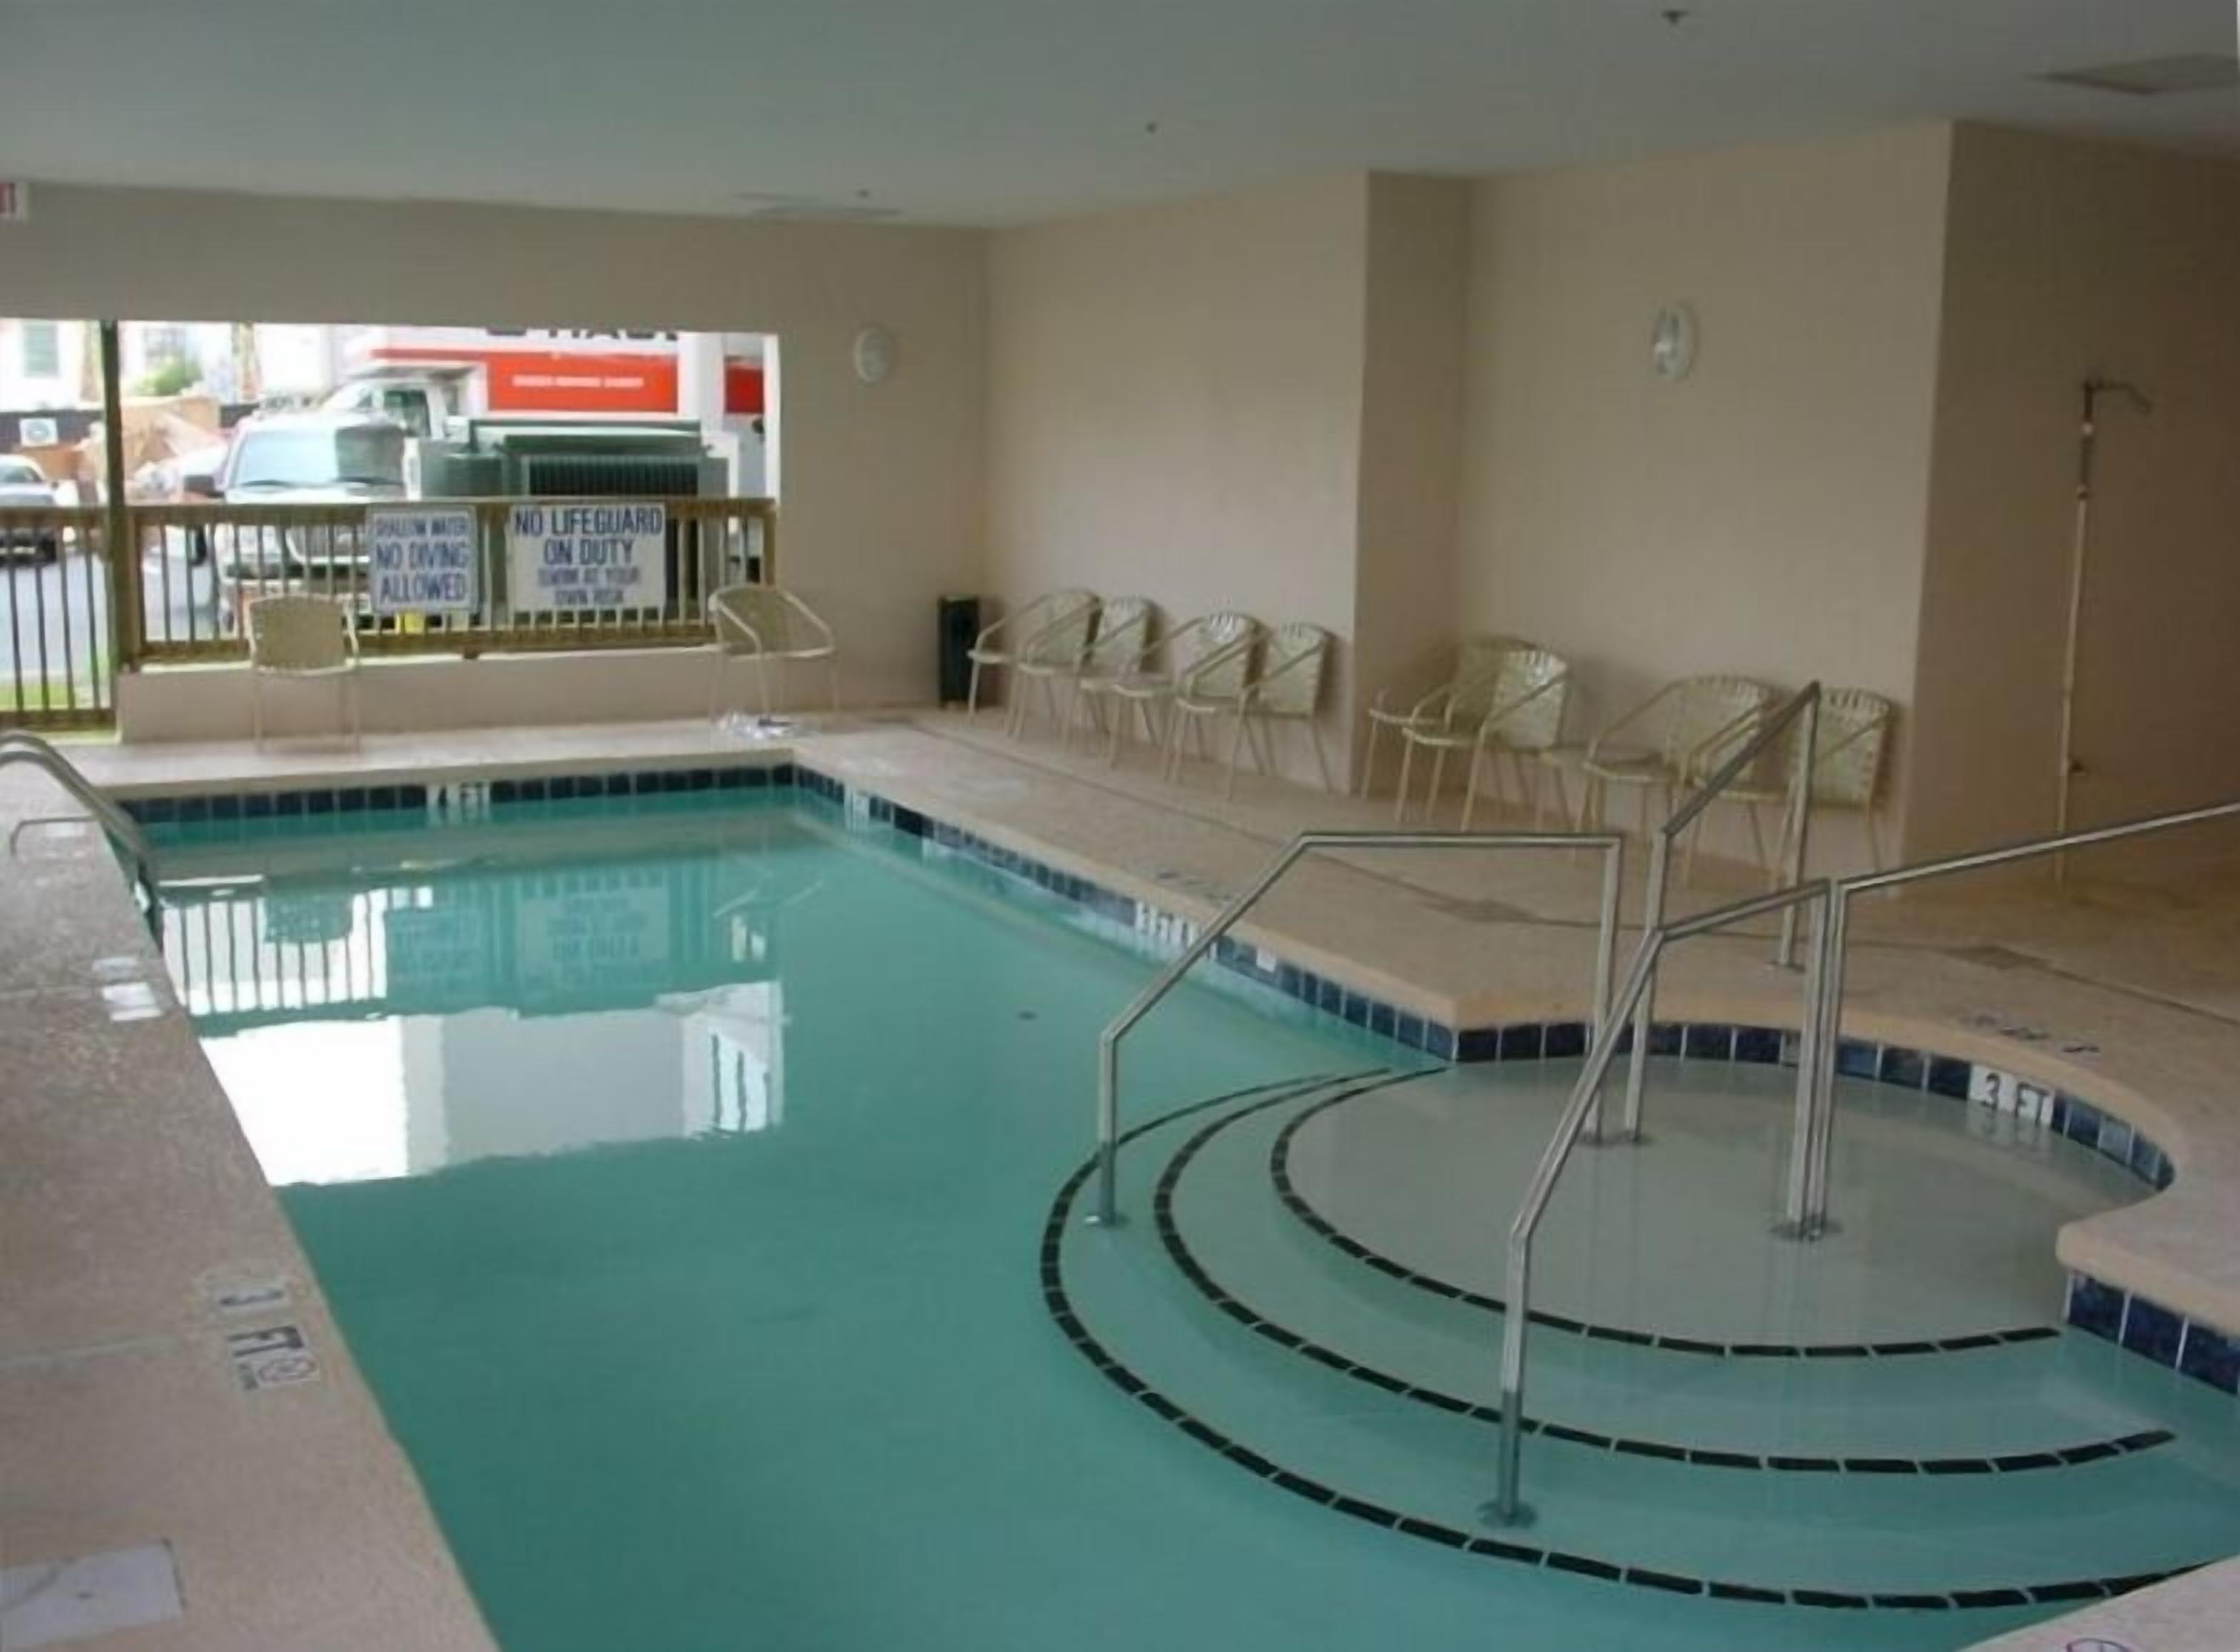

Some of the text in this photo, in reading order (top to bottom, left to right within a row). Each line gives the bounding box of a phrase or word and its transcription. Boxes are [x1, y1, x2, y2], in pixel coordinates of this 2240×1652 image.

[515, 507, 662, 536] NO LIFEGUARD
[377, 541, 468, 570] NO DIVING
[545, 538, 635, 565] ON DUTY
[380, 572, 467, 603] ALLOWED
[1980, 1072, 2050, 1123] 3 FT
